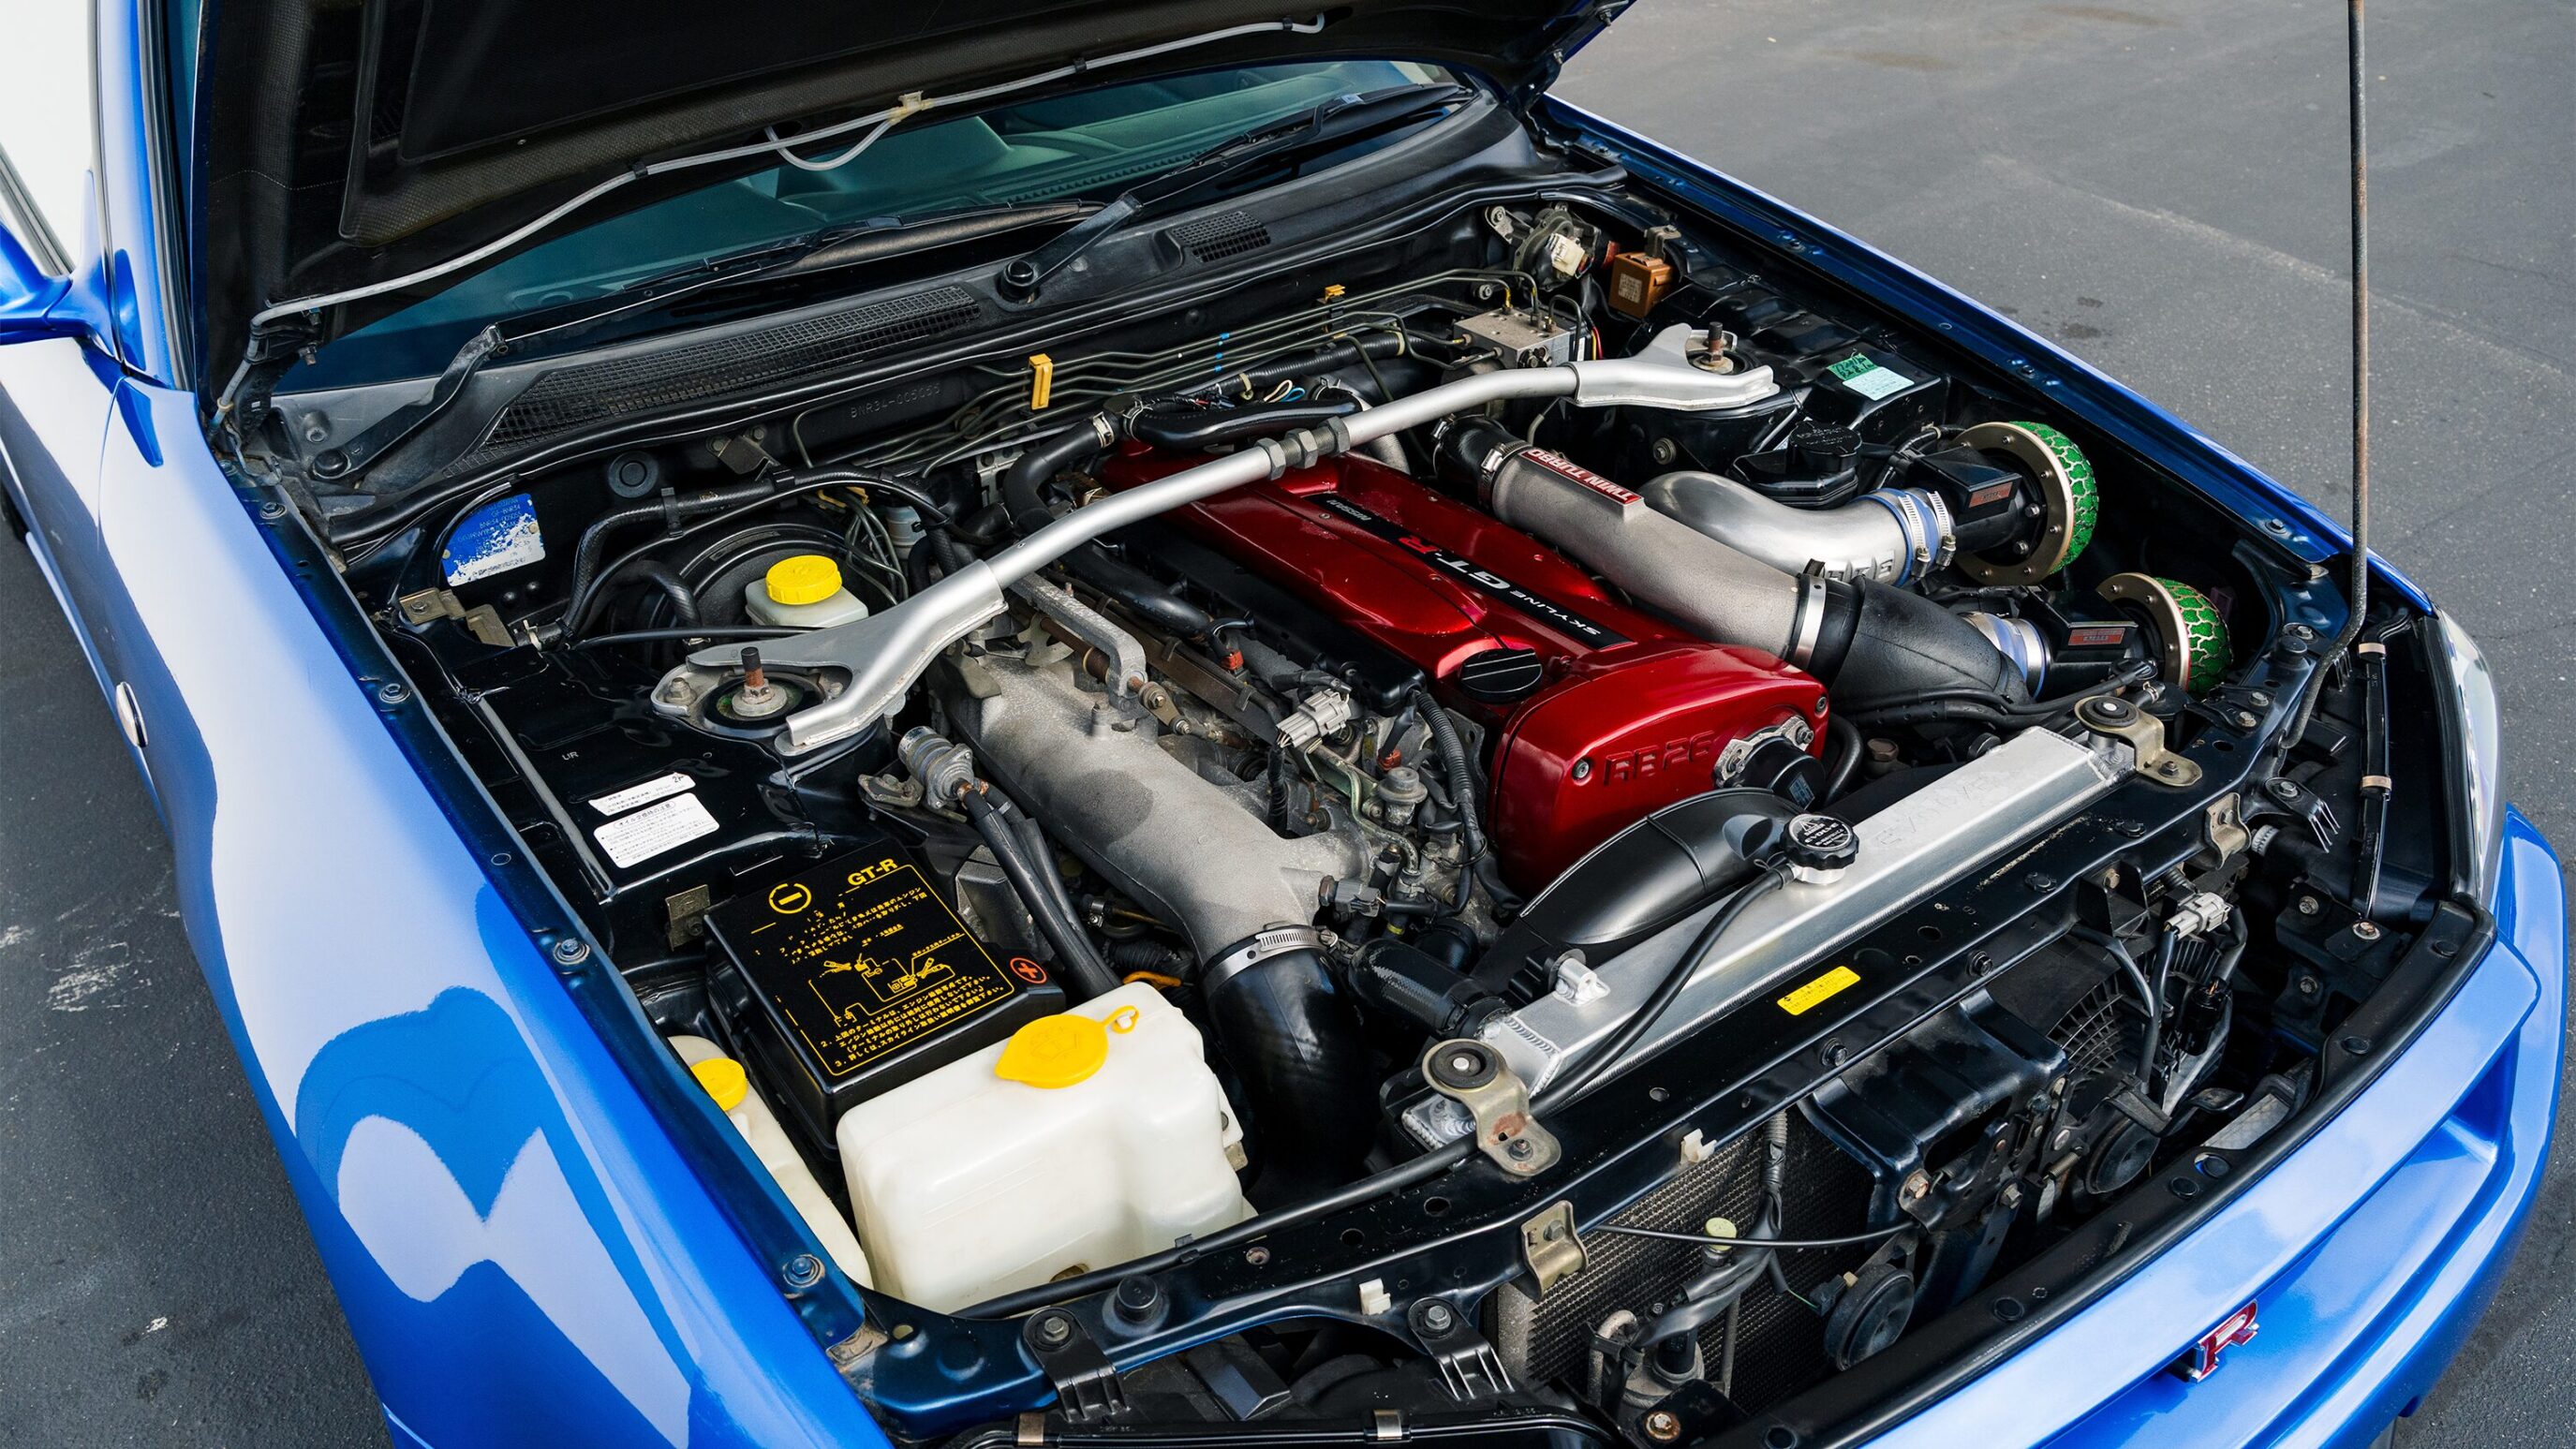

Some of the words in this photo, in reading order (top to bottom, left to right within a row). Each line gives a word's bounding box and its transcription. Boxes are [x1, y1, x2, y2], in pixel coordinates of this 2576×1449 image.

[1527, 449, 1585, 479] TURBO
[1584, 476, 1634, 500] TWIN
[1326, 499, 1371, 521] NISSAN
[1509, 589, 1601, 635] SKYLINE
[848, 858, 898, 886] GT-R
[2196, 1298, 2259, 1382] R
